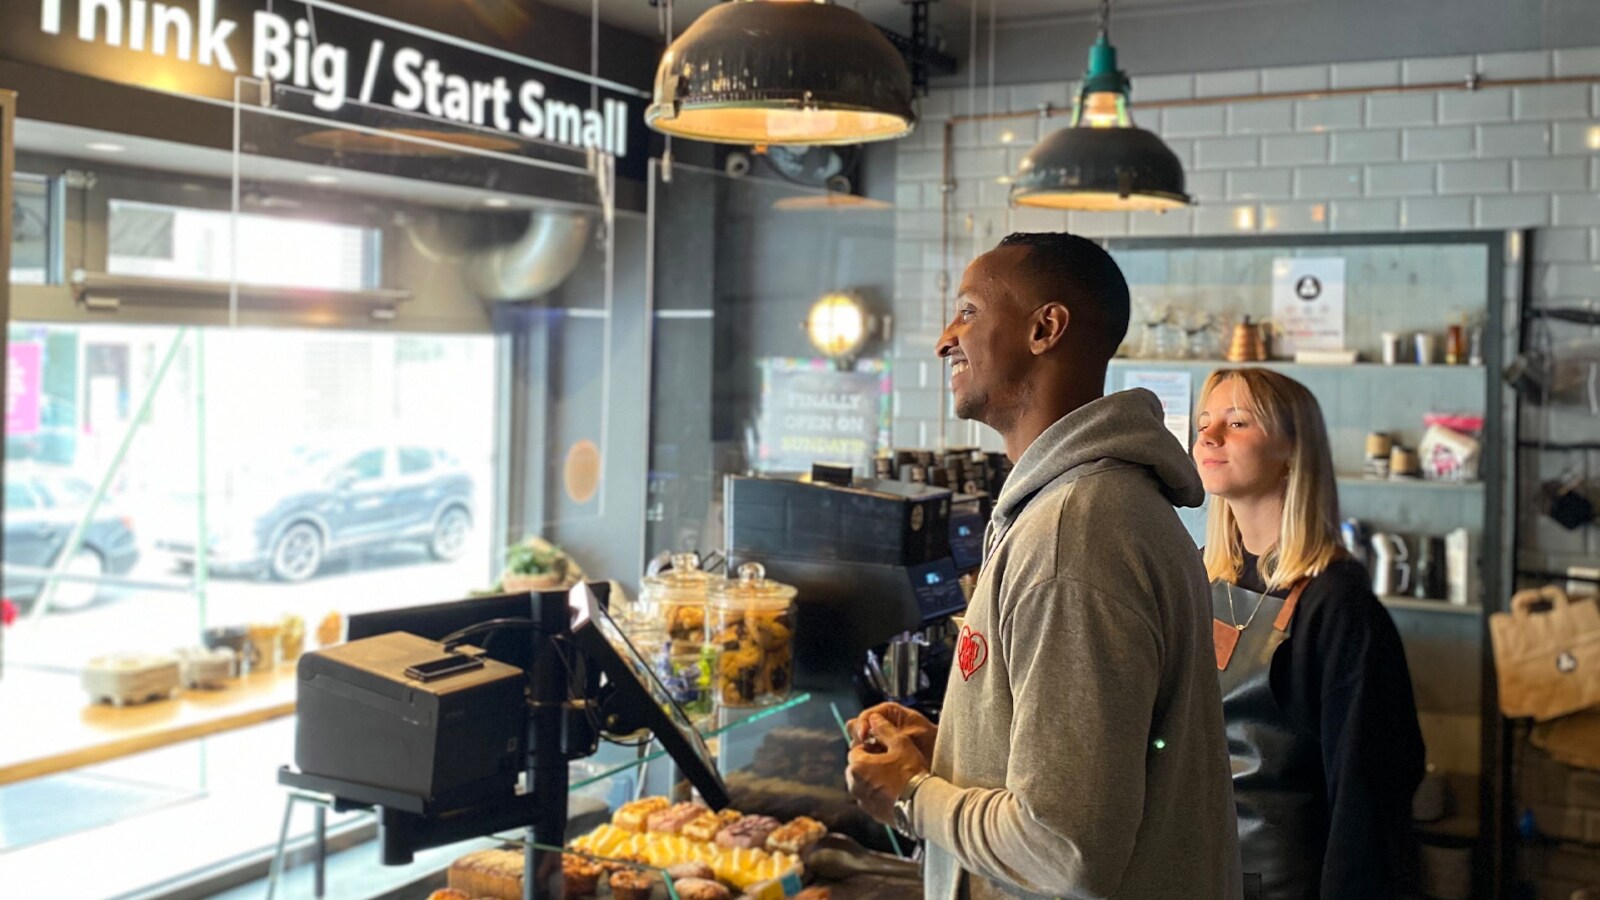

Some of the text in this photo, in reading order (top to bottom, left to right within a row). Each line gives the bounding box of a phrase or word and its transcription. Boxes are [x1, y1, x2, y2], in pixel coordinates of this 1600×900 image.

[253, 10, 347, 111] Big
[359, 39, 384, 105] /
[392, 47, 511, 131] Start
[519, 80, 628, 157] Small
[787, 393, 861, 410] FINALLY
[784, 415, 864, 432] OPEN ON
